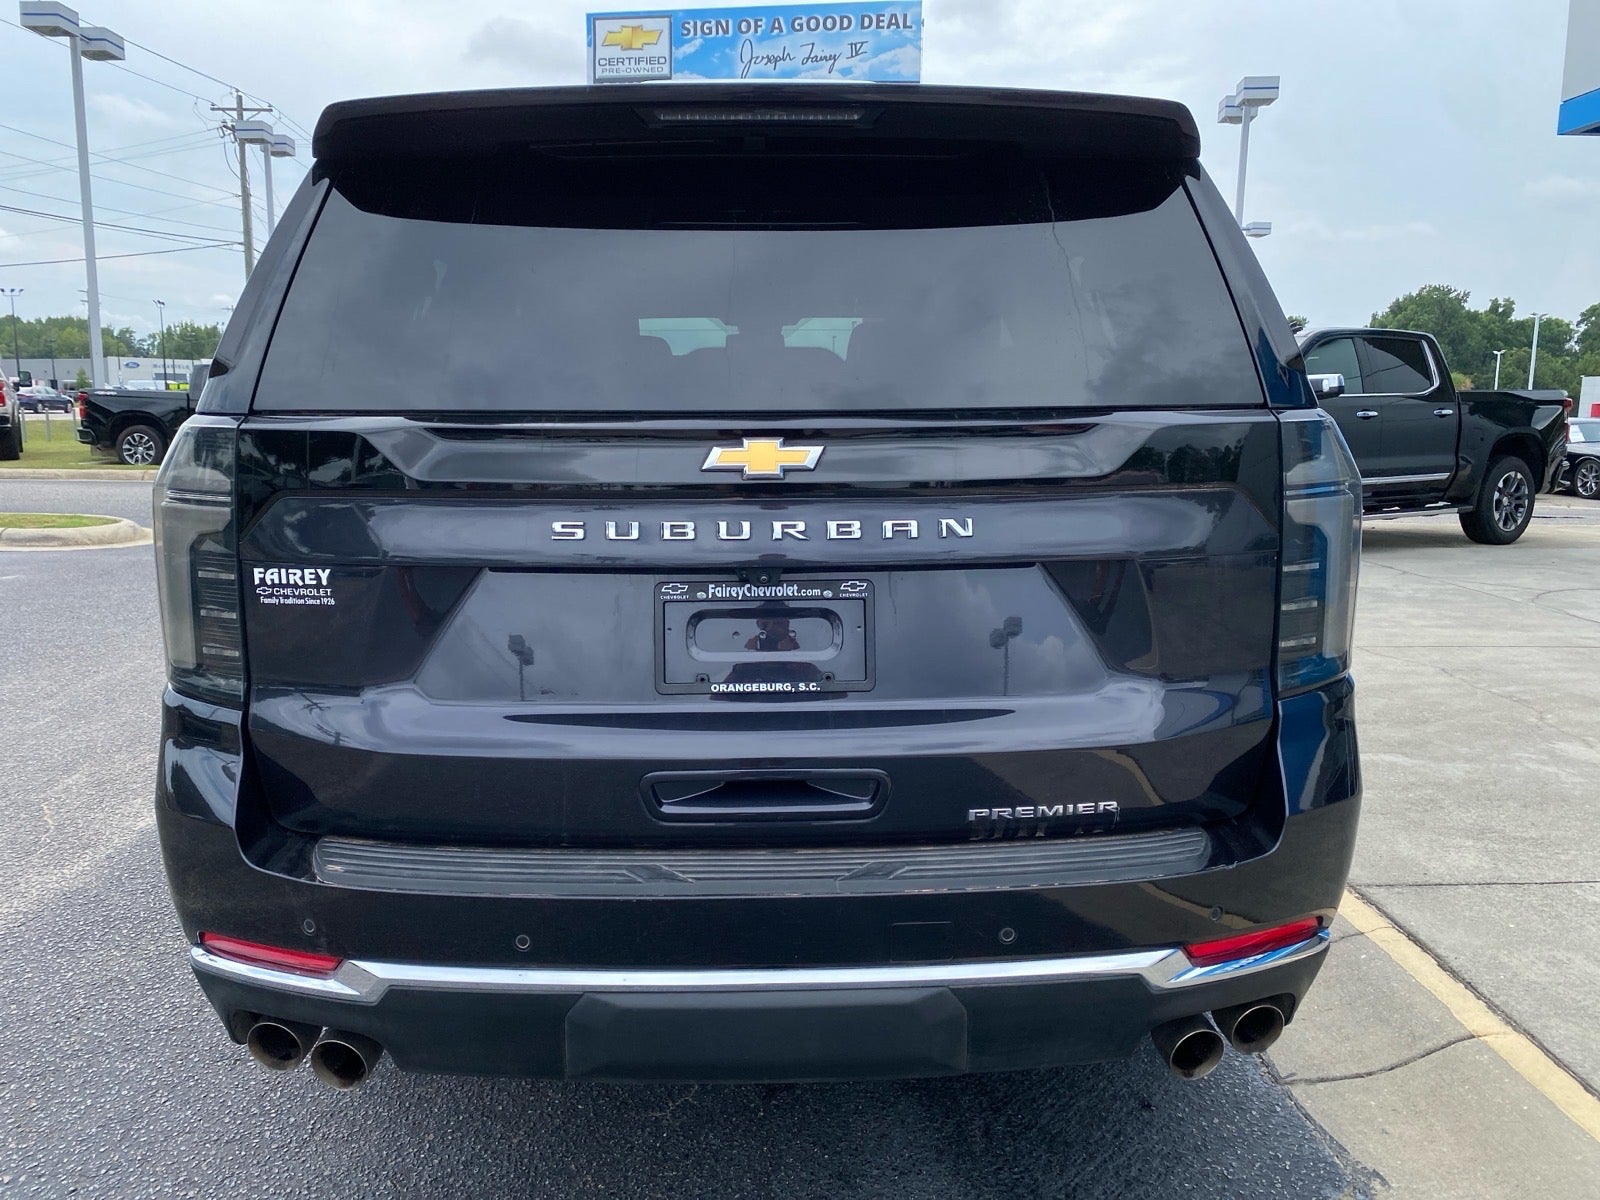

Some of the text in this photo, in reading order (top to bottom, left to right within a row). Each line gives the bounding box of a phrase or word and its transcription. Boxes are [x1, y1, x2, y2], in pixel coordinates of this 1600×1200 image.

[680, 13, 913, 37] SIGN OF A GOOD DEAL
[597, 56, 668, 67] CERTIFIED
[740, 38, 796, 79] Joseph
[601, 66, 664, 74] PRE-OWNED
[551, 517, 975, 541] SUBURBAN
[253, 567, 331, 586] FAIREY
[273, 587, 332, 596] CHEVROLET
[708, 583, 821, 600] FaireyChevrolet.com
[260, 596, 335, 606] Family Tradition Since 1926
[710, 681, 821, 693] ORANGEBURG, S.C.
[968, 801, 1120, 821] PREMIER
